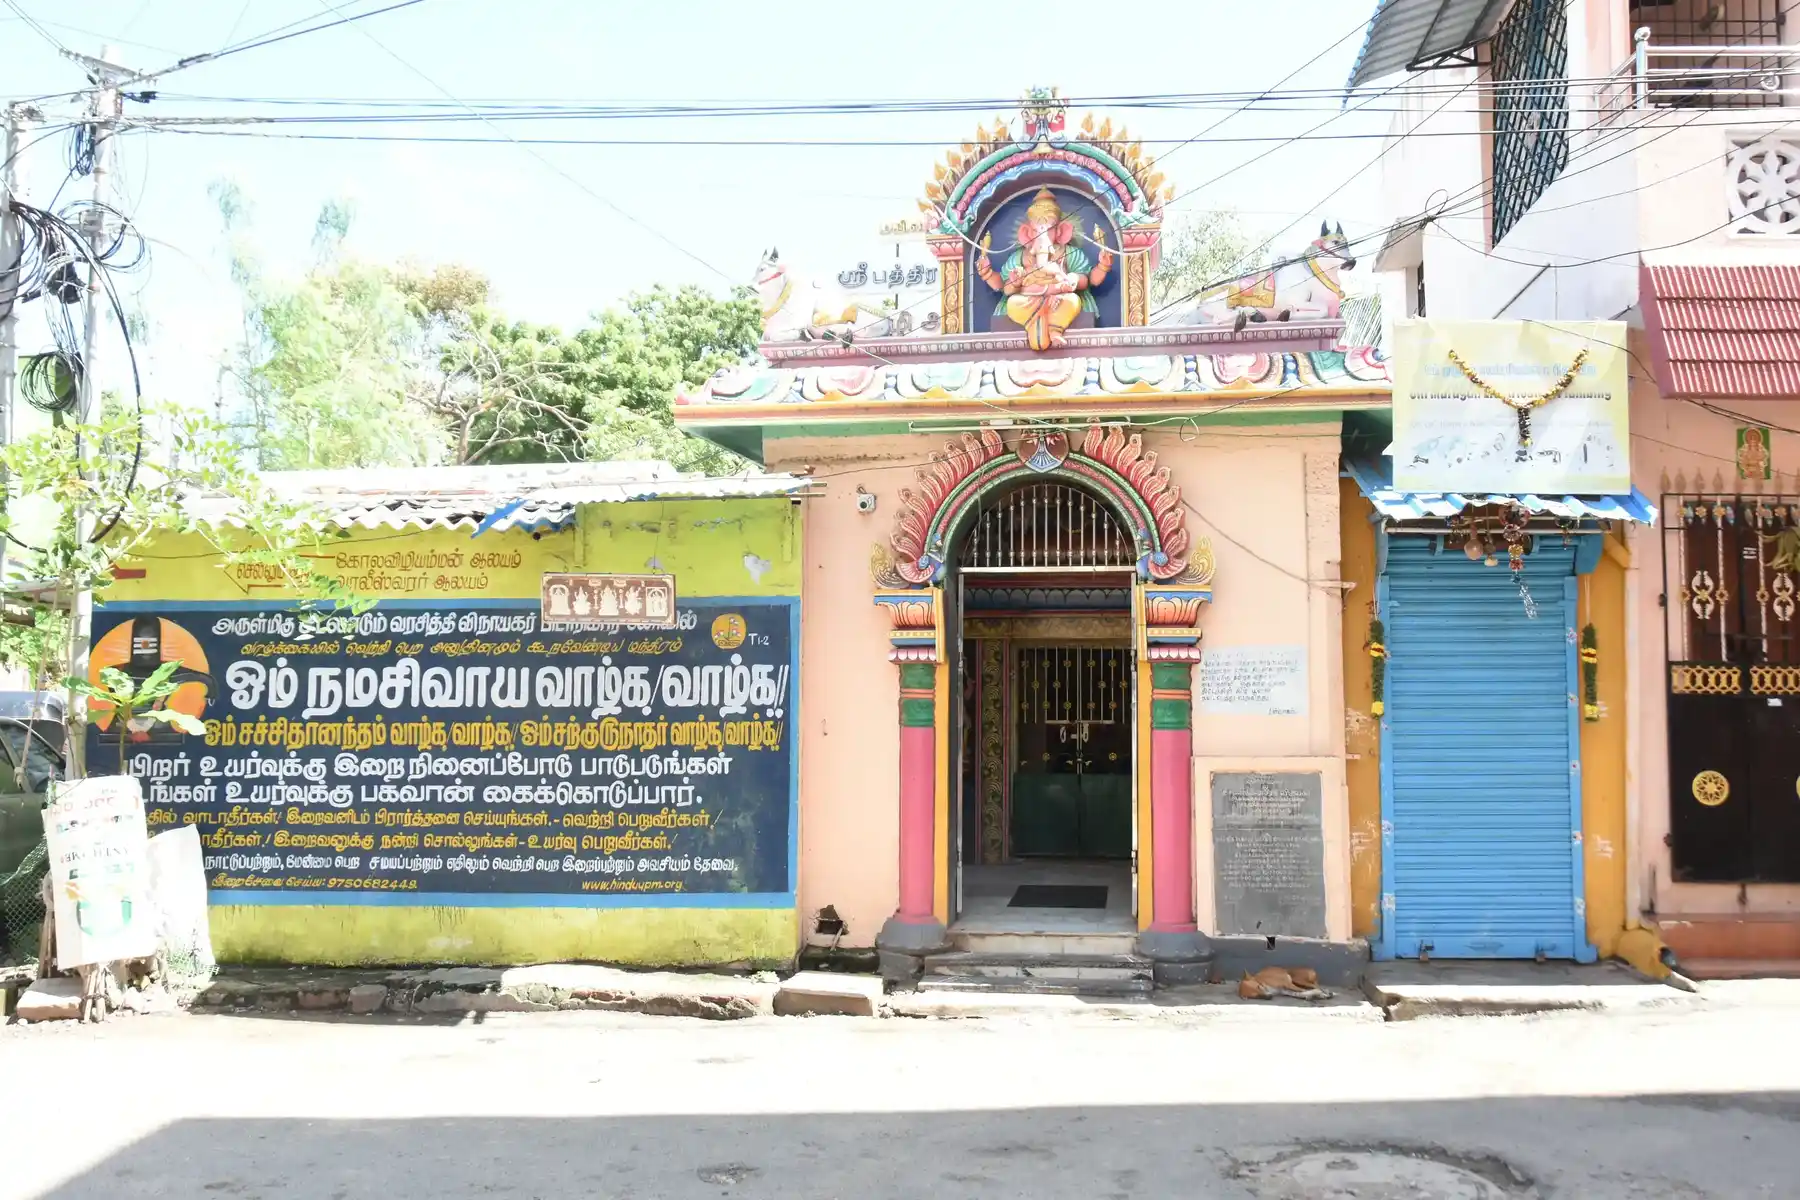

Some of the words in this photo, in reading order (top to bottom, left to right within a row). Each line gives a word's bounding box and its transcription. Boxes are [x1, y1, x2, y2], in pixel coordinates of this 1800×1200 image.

[470, 549, 522, 569] ஆலயம்
[433, 572, 488, 591] ஆலயம்
[212, 612, 294, 637] அருள்மிகு
[391, 611, 456, 636] வரசித்தி
[458, 611, 537, 635] விநாயகர்
[346, 639, 392, 657] வெற்றி
[395, 641, 423, 657] பெற
[226, 657, 298, 710] ஓம்
[302, 657, 528, 719] நமசிவாய
[204, 715, 236, 747] ஓம்
[239, 714, 386, 751] சச்சிதானந்தம்
[128, 751, 191, 781] பிறர்
[200, 751, 326, 781] உயர்வுக்கு
[334, 752, 405, 782] இறை
[408, 750, 572, 782] நினைப்போடு
[581, 750, 732, 777] பாடுபடுங்கள்
[226, 777, 354, 808] உயர்வுக்கு
[361, 776, 475, 803] பகவான்
[483, 777, 702, 808] கைக்கொடுப்பார்.
[287, 807, 370, 827] இறைவனிடம்
[375, 806, 461, 828] பிரார்த்தனை
[563, 811, 614, 830] வெற்றி
[274, 828, 374, 852] இறைவனுக்கு
[380, 831, 418, 851] நன்றி
[286, 854, 332, 870] மேன்மை
[335, 855, 360, 870] பெற
[369, 853, 443, 872] சமயப்பற்றும்
[446, 854, 490, 874] எதிலும்
[492, 857, 534, 873] வெற்றி
[536, 857, 560, 872] பெற
[562, 855, 634, 875] இறைப்பற்றும்
[637, 857, 690, 872] அவசியம்
